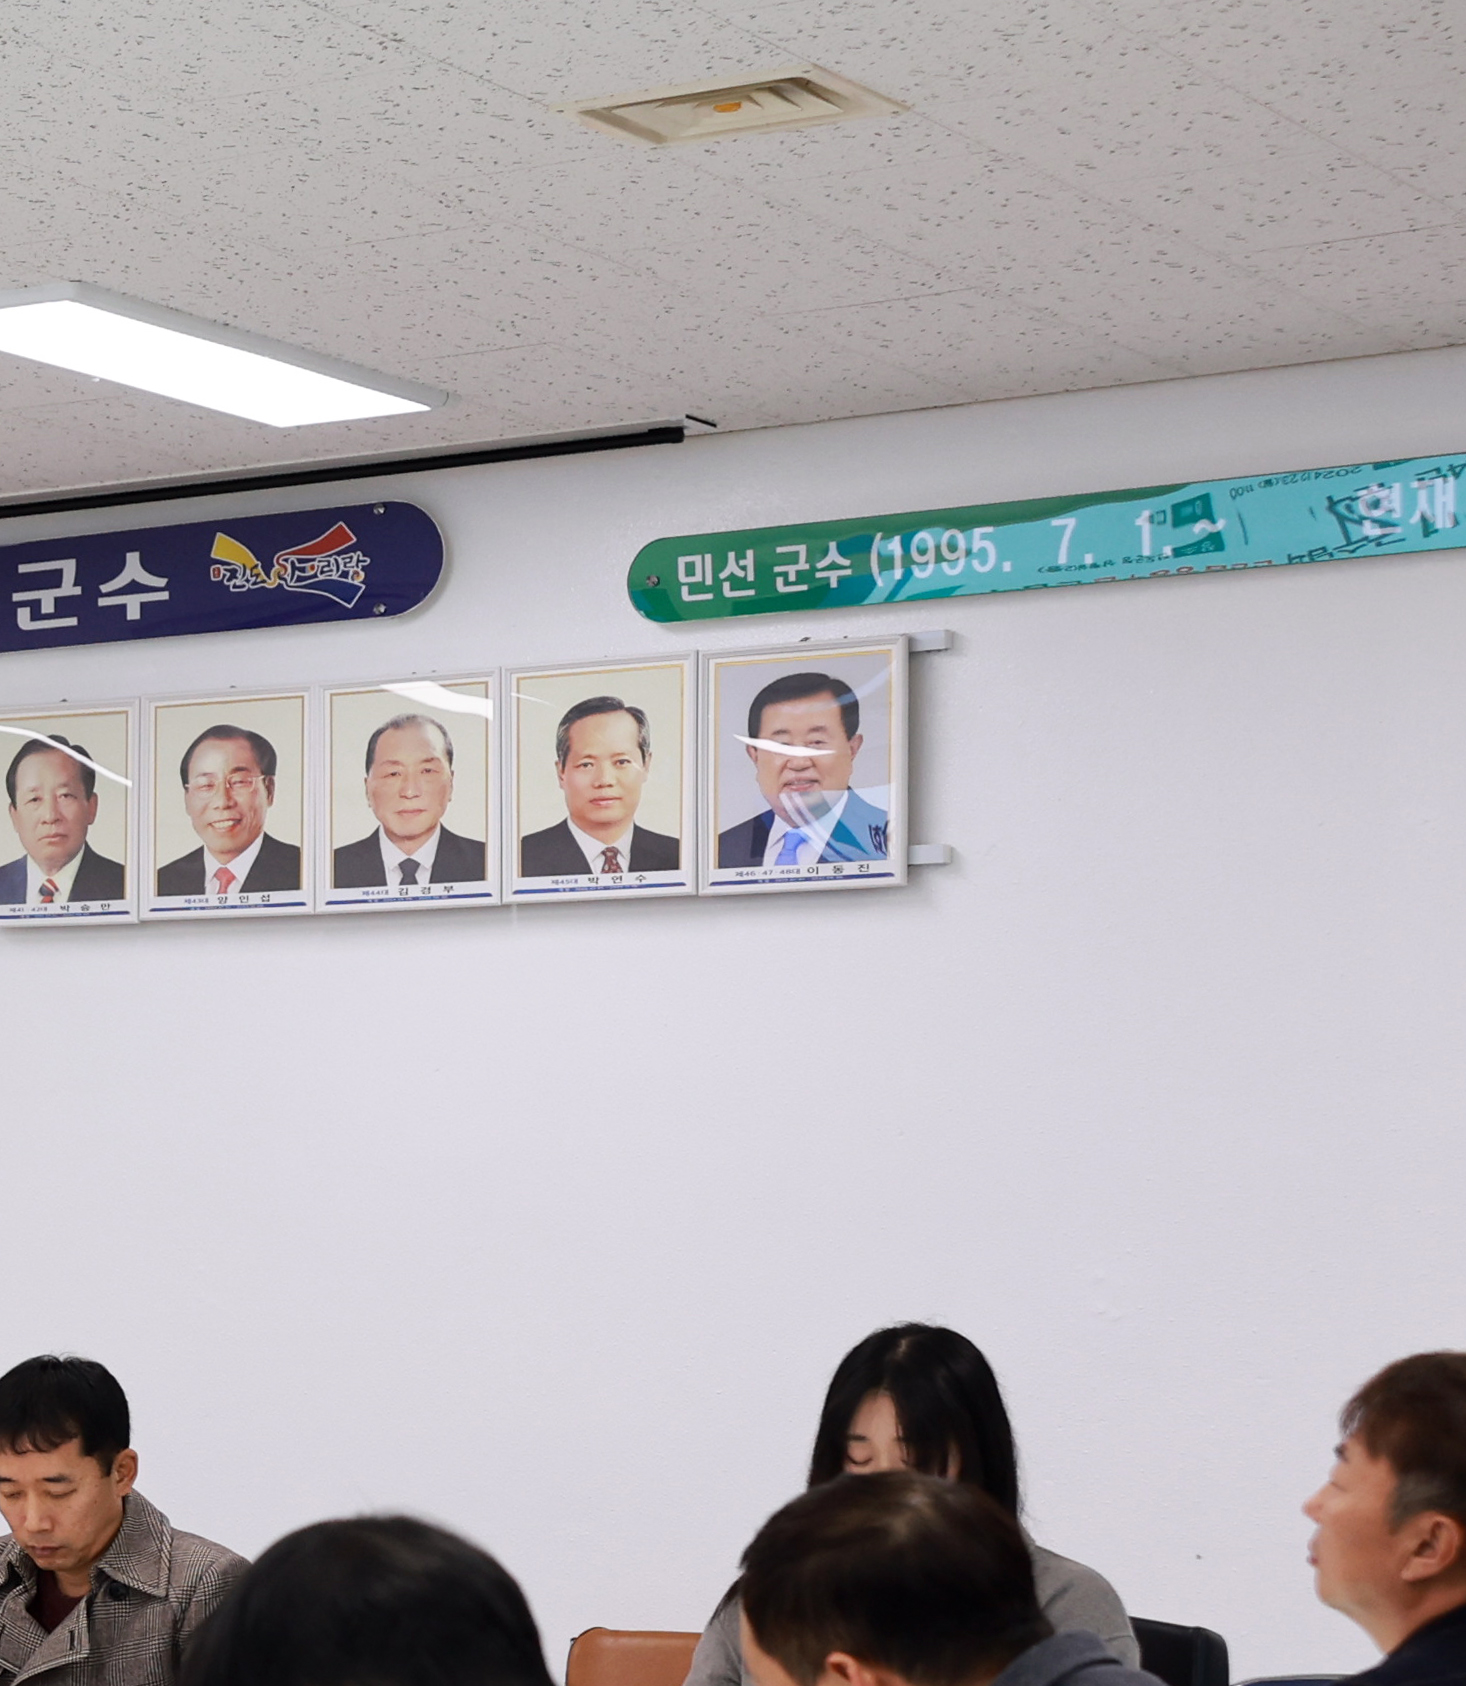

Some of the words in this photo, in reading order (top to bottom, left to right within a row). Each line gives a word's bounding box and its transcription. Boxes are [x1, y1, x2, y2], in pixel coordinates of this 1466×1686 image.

[679, 550, 754, 600] 민선
[775, 543, 851, 591] 군수
[869, 527, 1012, 588] (1995.
[1049, 518, 1095, 565] 7.
[1134, 509, 1174, 557] 1.
[1358, 474, 1457, 537] 현재
